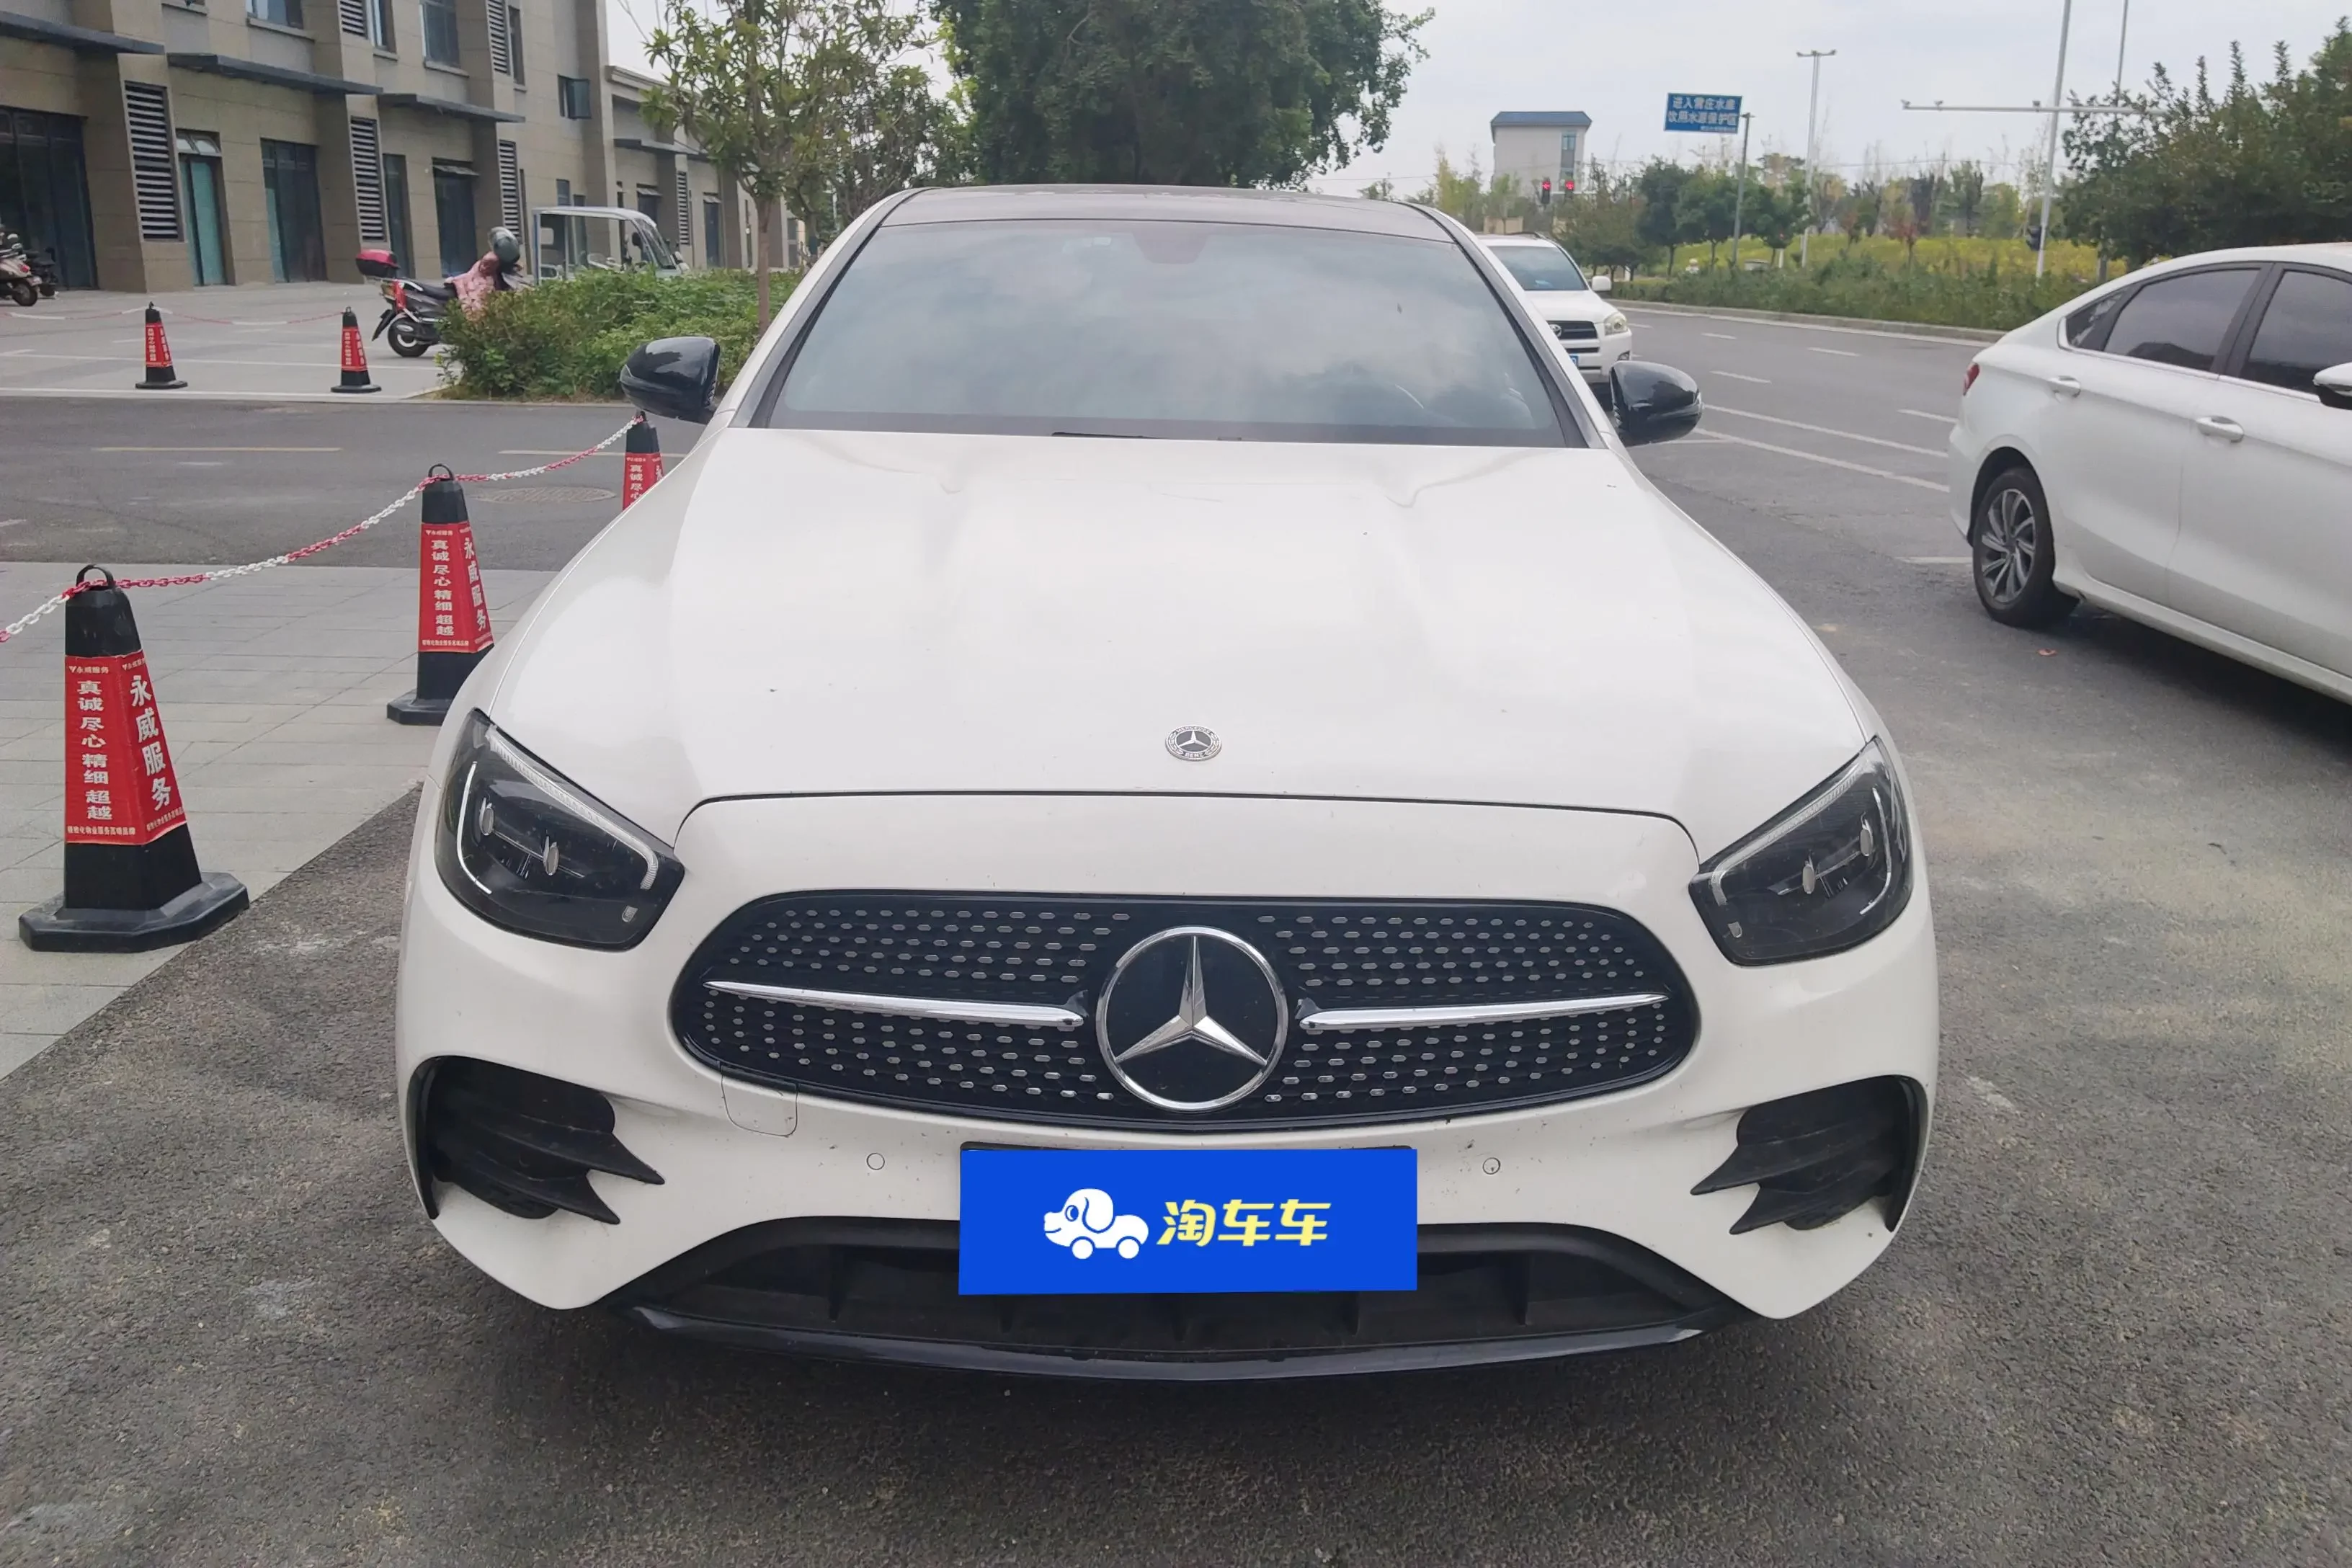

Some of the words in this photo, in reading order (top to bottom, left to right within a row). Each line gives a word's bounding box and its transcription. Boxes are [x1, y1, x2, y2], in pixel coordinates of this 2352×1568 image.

[77, 680, 112, 821] 真诚尽心精细超越
[130, 675, 172, 811] 永威服务
